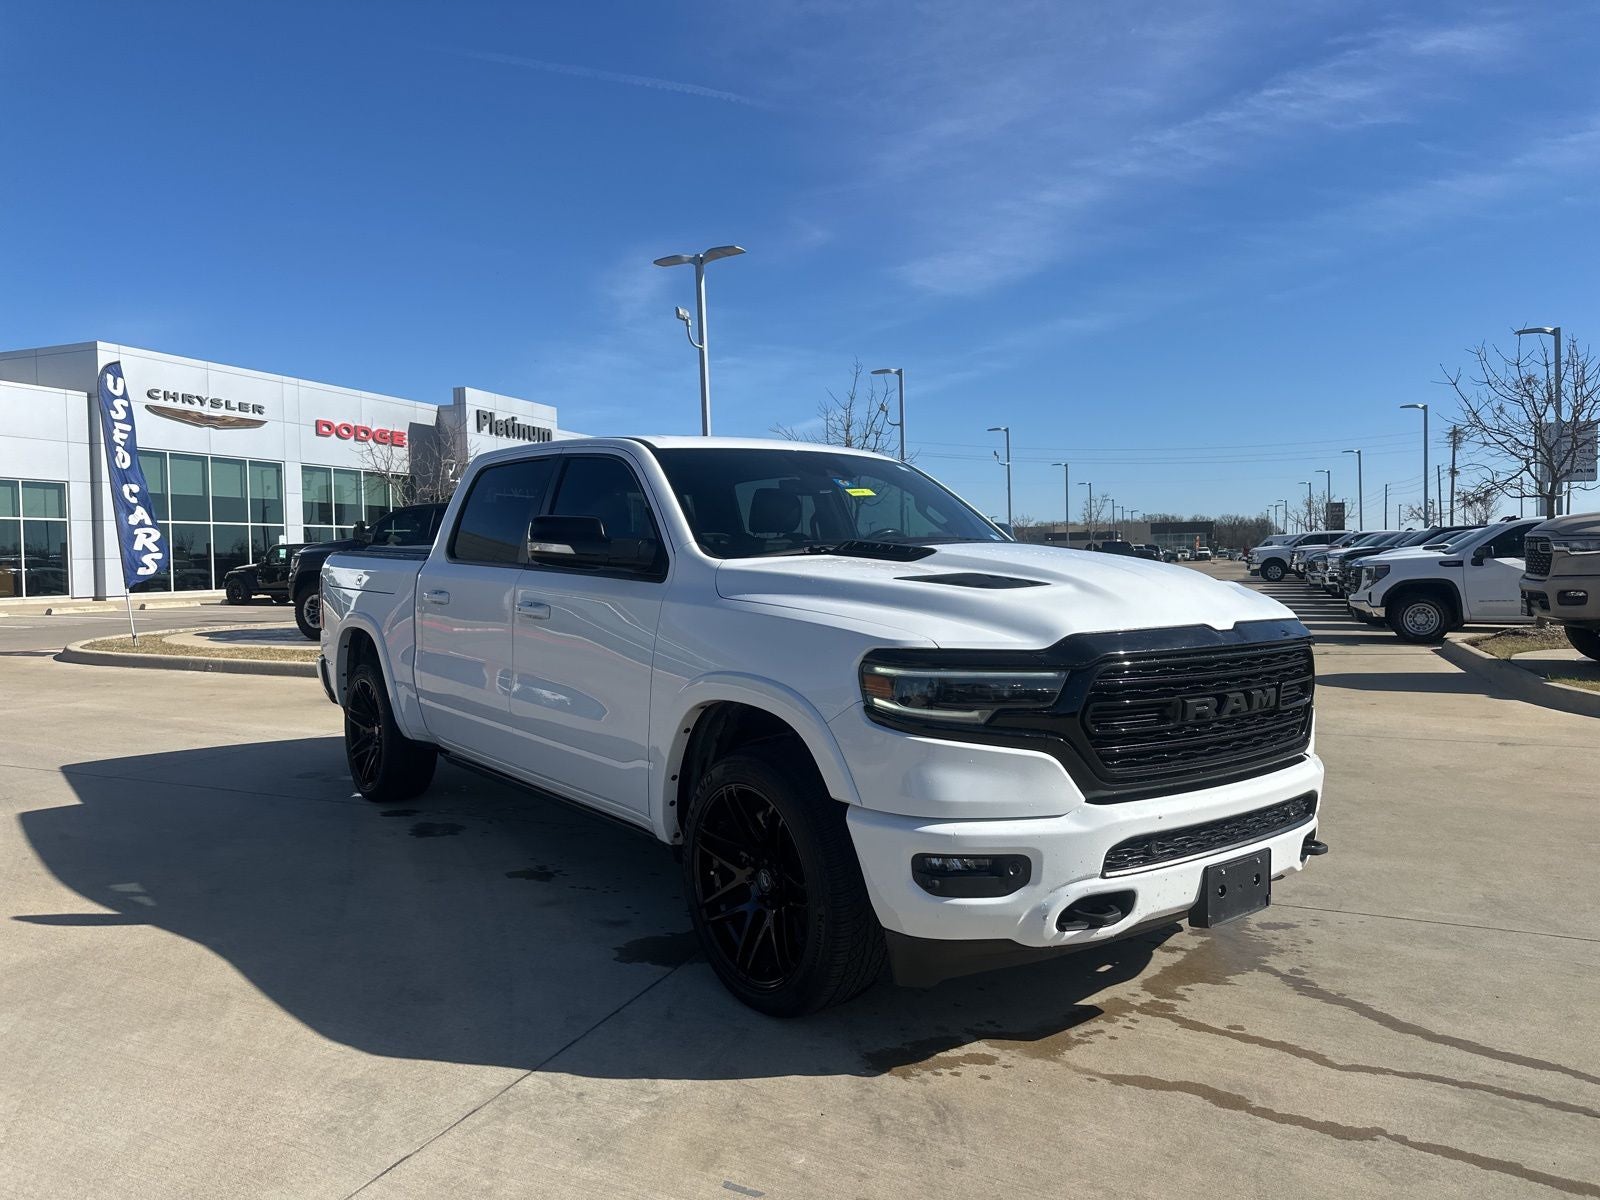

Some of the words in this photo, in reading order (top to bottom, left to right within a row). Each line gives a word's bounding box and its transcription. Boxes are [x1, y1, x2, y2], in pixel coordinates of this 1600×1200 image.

[146, 388, 265, 415] CHRYSLER
[315, 419, 407, 448] DODGE
[476, 409, 553, 442] Platinum
[106, 373, 132, 470] USED
[122, 483, 164, 576] CARS
[1181, 687, 1277, 720] RAM
